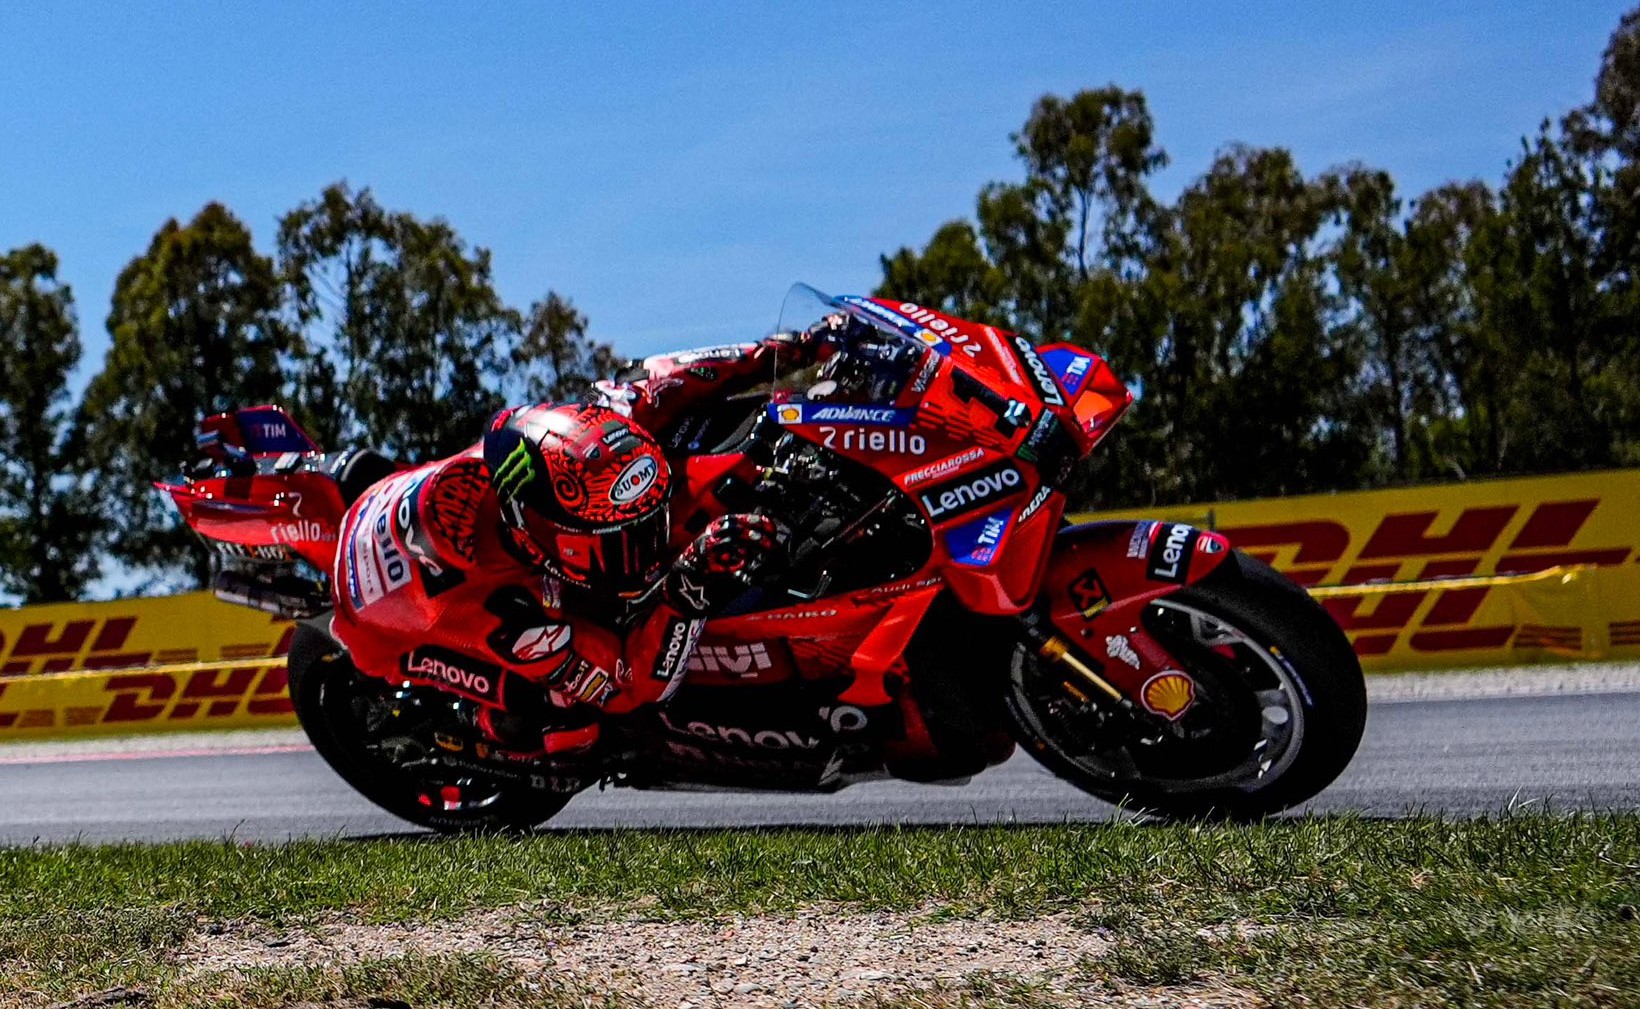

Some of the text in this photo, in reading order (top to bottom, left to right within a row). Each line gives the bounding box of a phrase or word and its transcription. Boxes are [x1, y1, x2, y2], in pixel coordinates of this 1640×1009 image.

[1015, 336, 1064, 406] Lenovo
[1066, 355, 1091, 376] TIM
[811, 405, 896, 423] ADVANCE
[263, 423, 287, 438] TIM
[843, 427, 926, 455] riello
[921, 468, 1020, 518] Lenovo
[270, 518, 321, 544] riello
[977, 516, 1004, 545] TIM
[0, 617, 152, 677] HL
[656, 622, 686, 677] Lenovo
[408, 651, 490, 694] Lenovo
